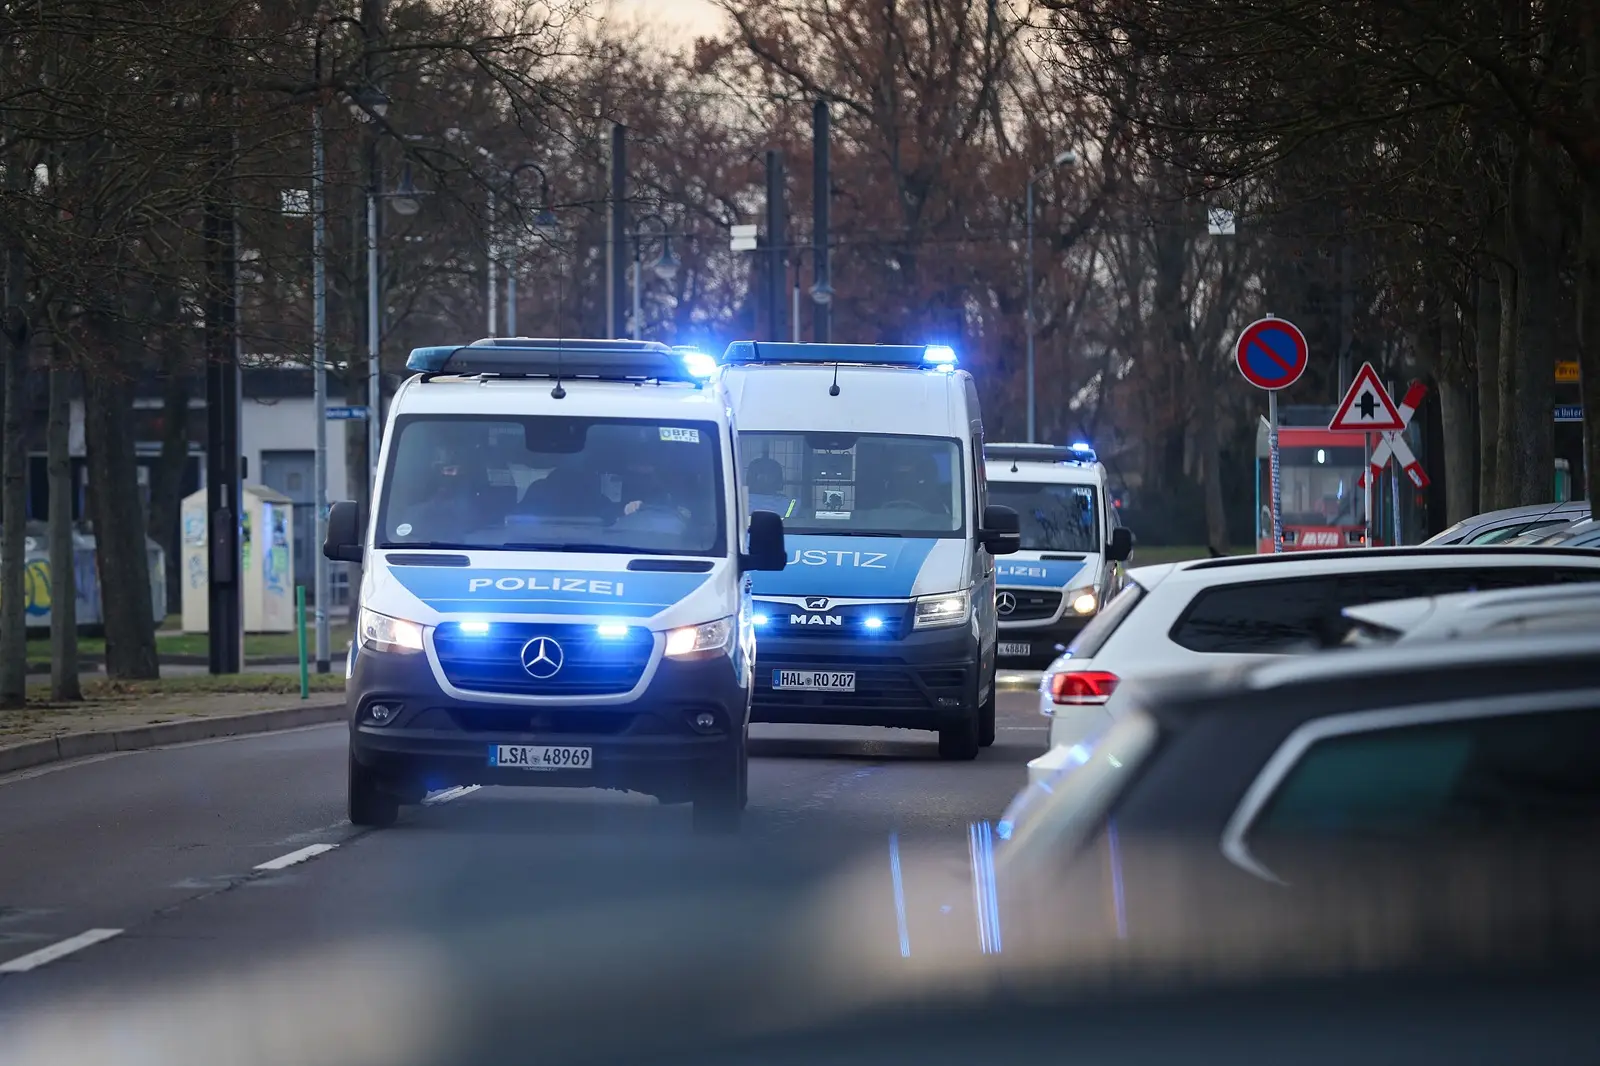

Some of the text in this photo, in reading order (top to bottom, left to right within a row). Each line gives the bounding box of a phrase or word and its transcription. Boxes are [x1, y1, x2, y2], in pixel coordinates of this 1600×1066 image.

[672, 429, 698, 437] BFE
[786, 549, 888, 568] USTIZ
[995, 566, 1047, 578] LIZEI
[468, 577, 624, 596] POLIZEI
[790, 614, 842, 626] MAN
[781, 672, 805, 686] HAL
[813, 673, 829, 687] RO
[831, 674, 854, 688] 207
[499, 747, 590, 766] LSA 48969
